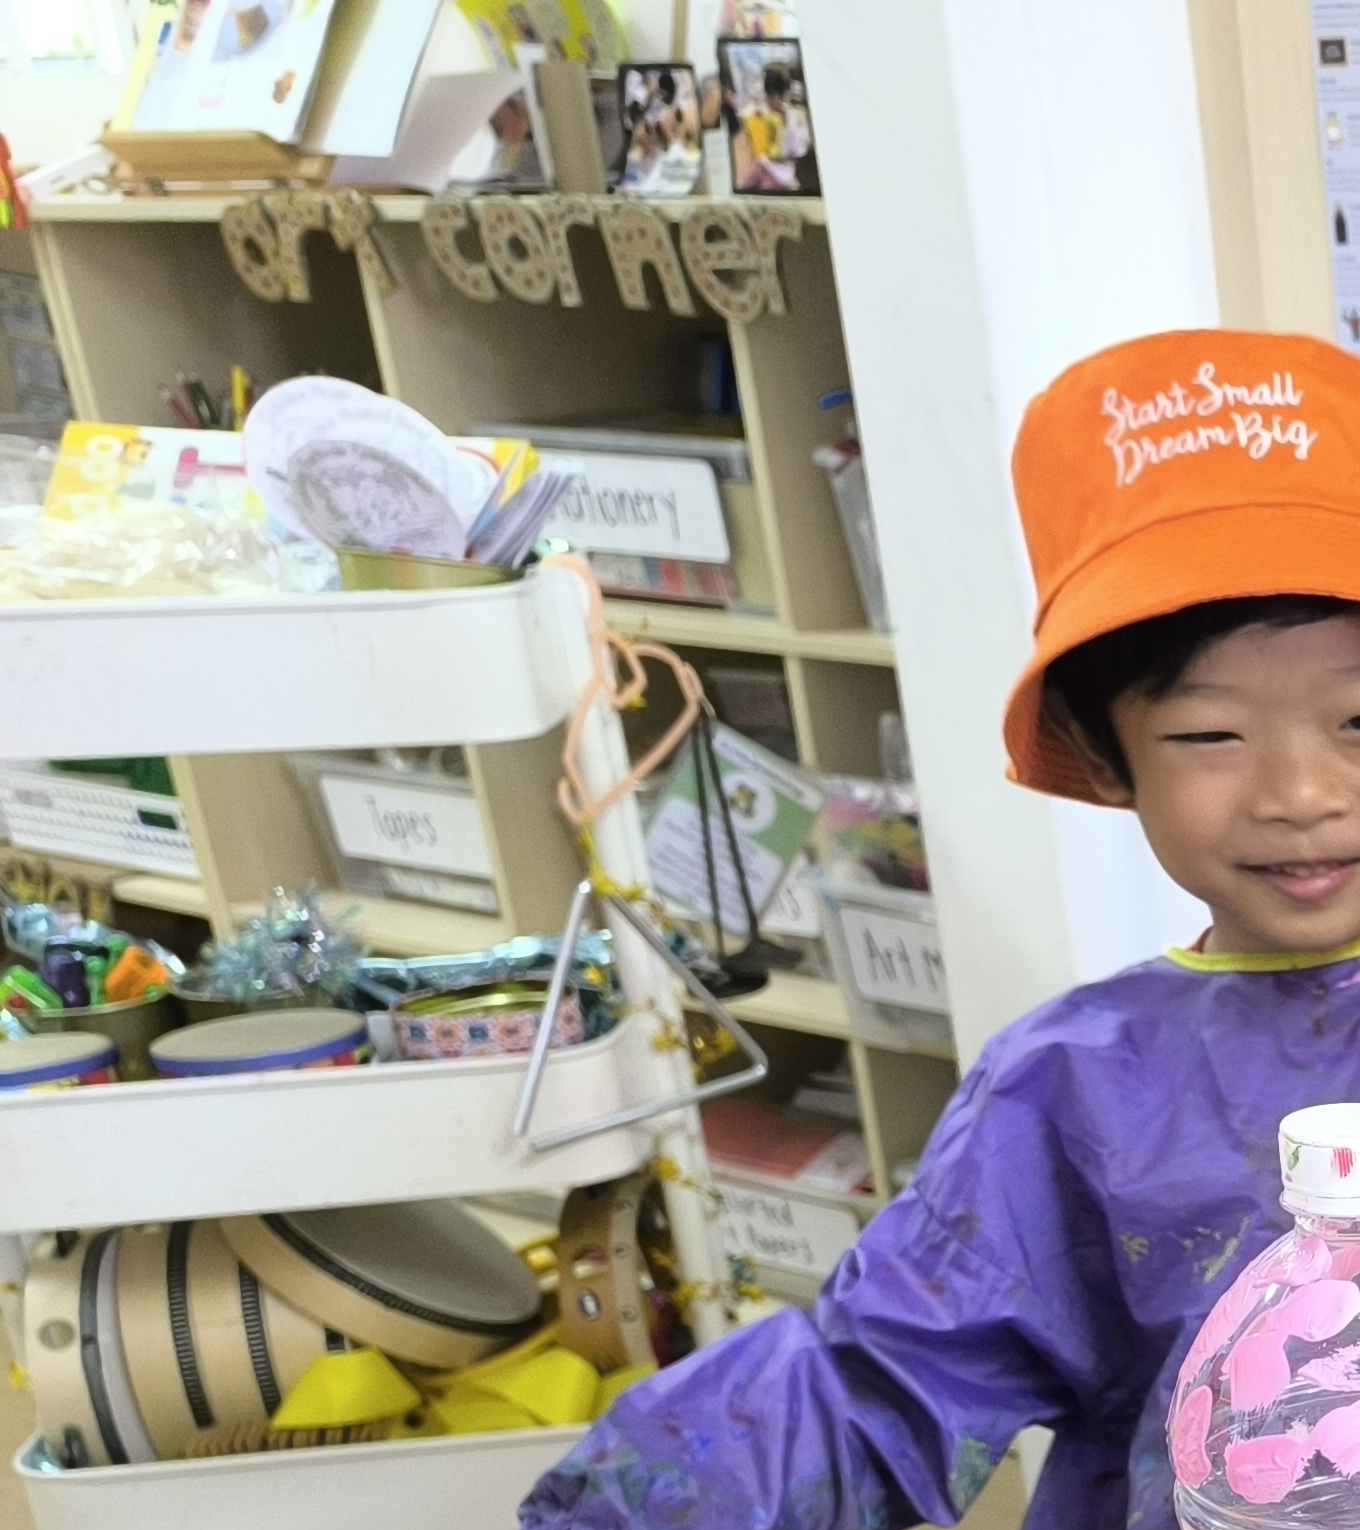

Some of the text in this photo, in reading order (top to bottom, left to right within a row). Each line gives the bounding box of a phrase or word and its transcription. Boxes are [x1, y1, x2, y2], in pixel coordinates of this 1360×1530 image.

[420, 190, 803, 322] corner
[1101, 361, 1304, 446] Start Small
[1113, 411, 1318, 489] Dream Big
